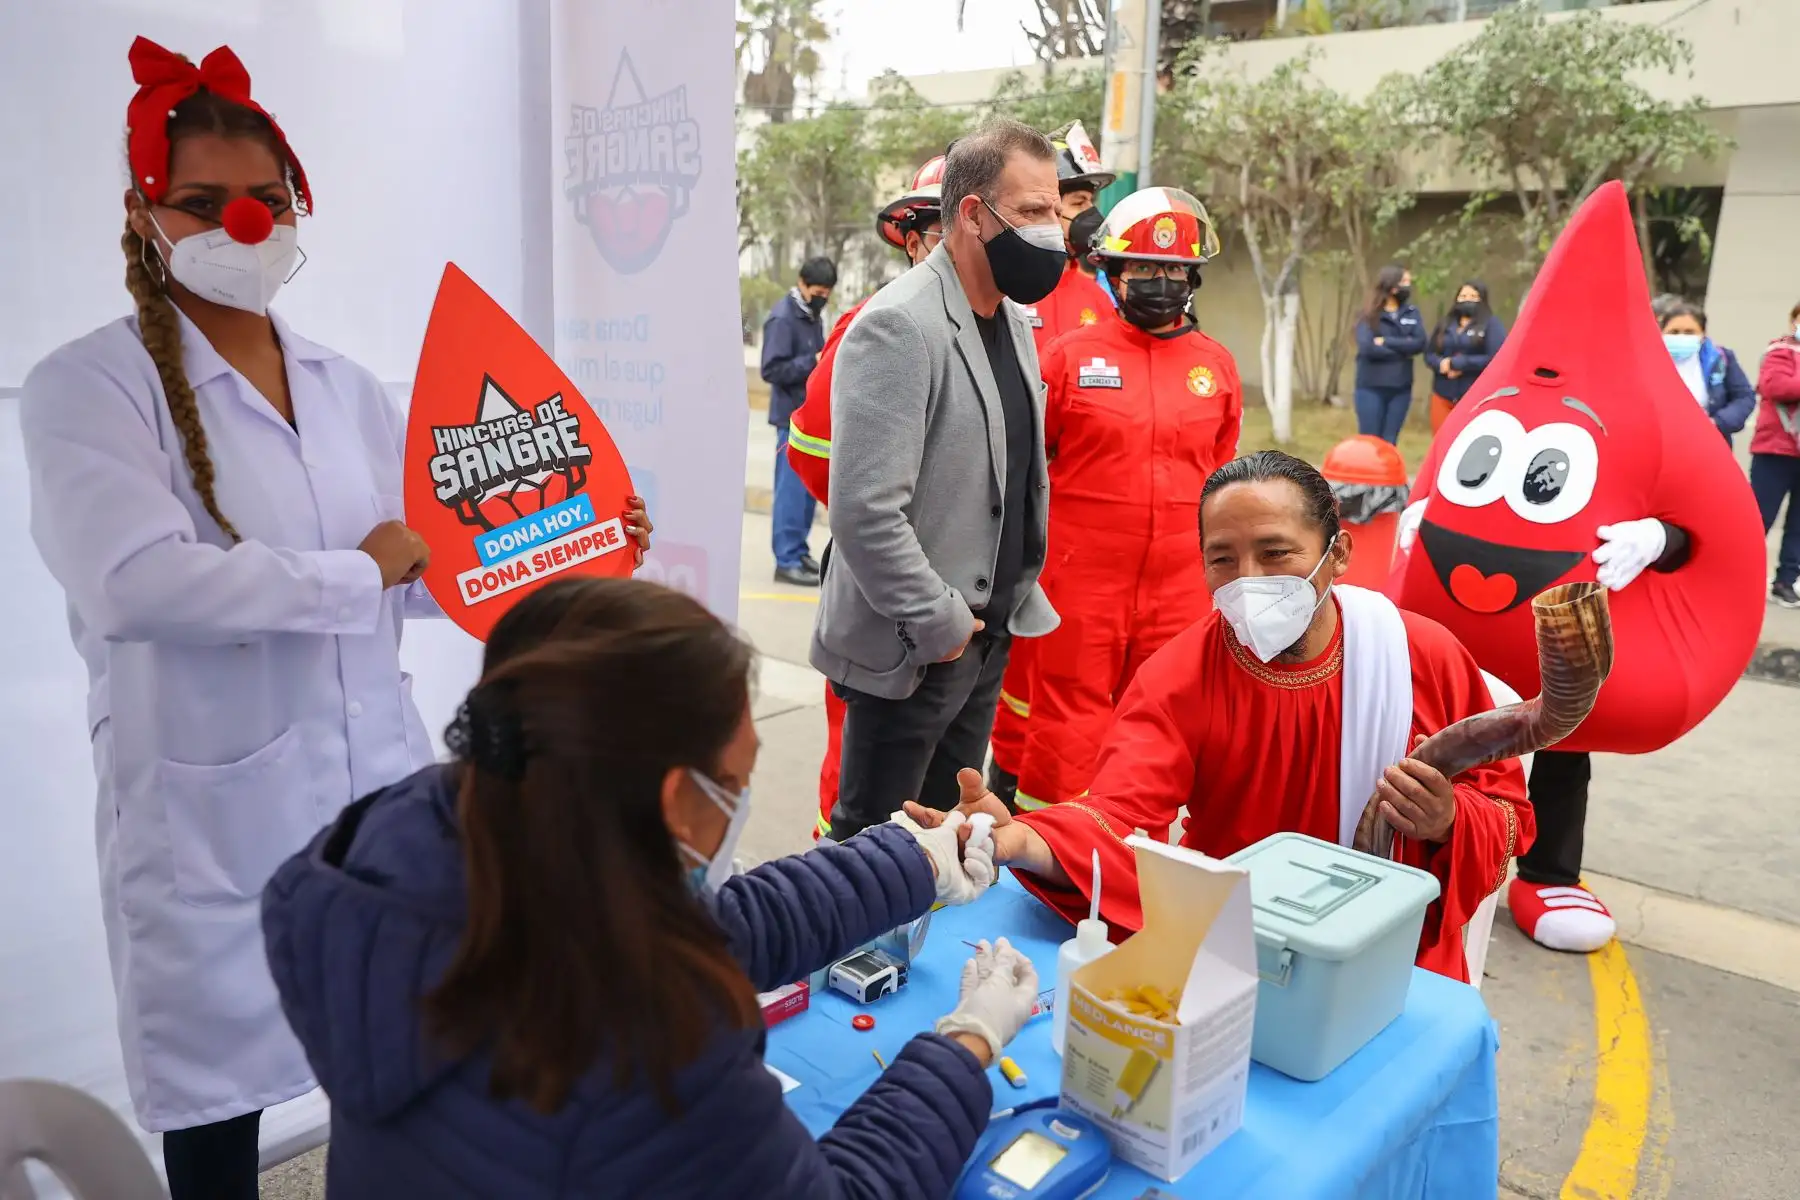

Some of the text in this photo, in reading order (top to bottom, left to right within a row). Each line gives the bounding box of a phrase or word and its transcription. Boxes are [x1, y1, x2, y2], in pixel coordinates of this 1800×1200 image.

[433, 394, 571, 454] HINCHAS DE
[429, 416, 591, 501] SANGRE
[483, 503, 590, 559] DONA HOY,
[464, 525, 620, 600] DONA SIEMPRE
[1072, 992, 1167, 1049] MEDLANCE
